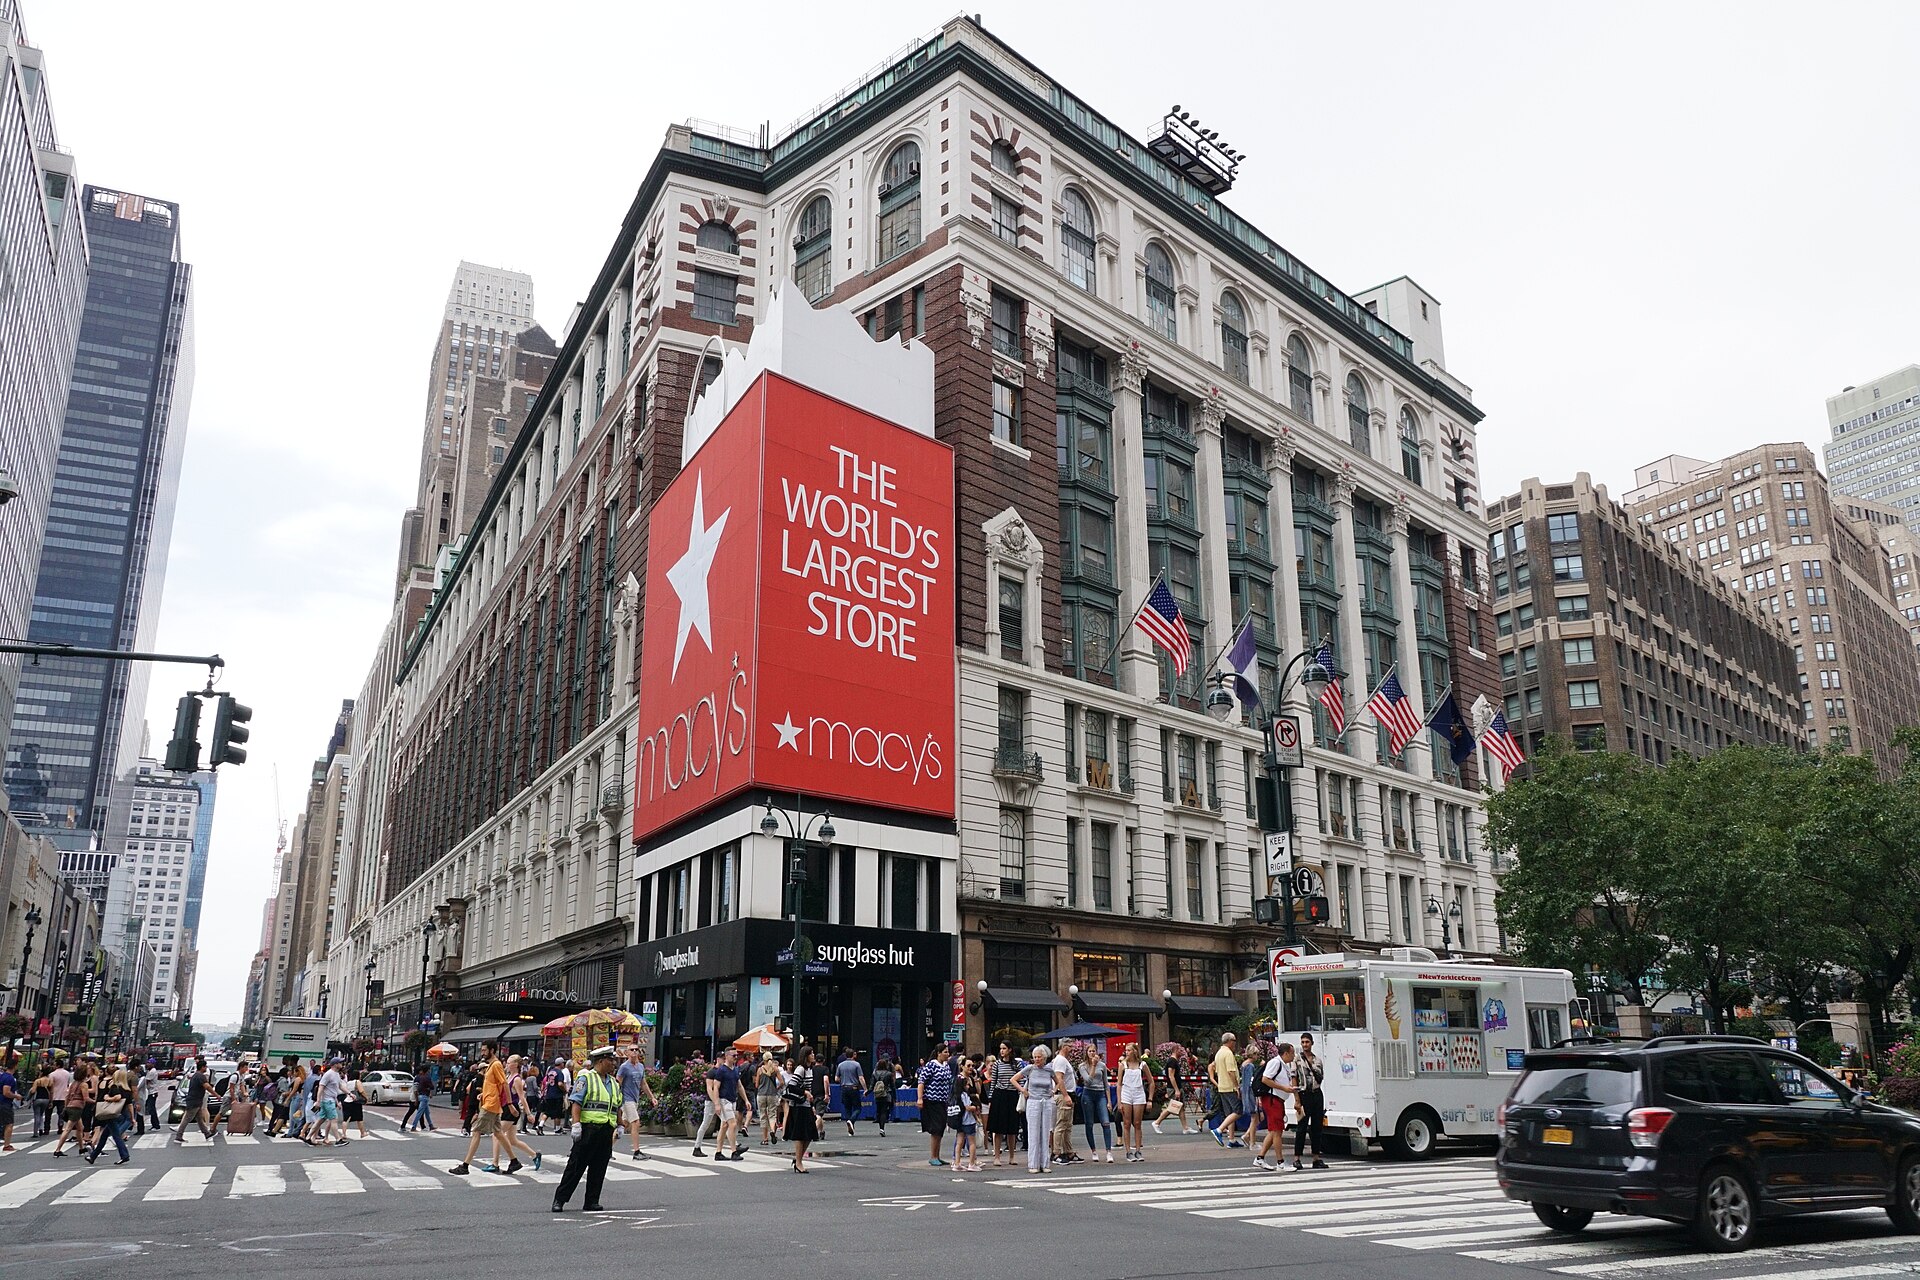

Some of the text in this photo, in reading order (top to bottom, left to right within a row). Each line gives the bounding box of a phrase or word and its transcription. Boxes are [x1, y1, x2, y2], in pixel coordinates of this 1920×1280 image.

[829, 444, 897, 508] THE
[781, 476, 940, 570] WORLD'S
[781, 529, 937, 616] LARGEST
[807, 591, 917, 662] STORE
[808, 715, 943, 786] macy's
[1269, 836, 1286, 846] KEEP
[1270, 861, 1289, 872] RIGHT
[57, 950, 68, 978] KAY
[662, 945, 699, 975] sunglass hut
[805, 964, 829, 974] Broadway
[817, 941, 915, 969] sunglass hut
[1418, 973, 1481, 982] #NewYorkIceCream
[530, 987, 578, 1004] macy's
[1442, 1109, 1495, 1122] SOFT ICE
